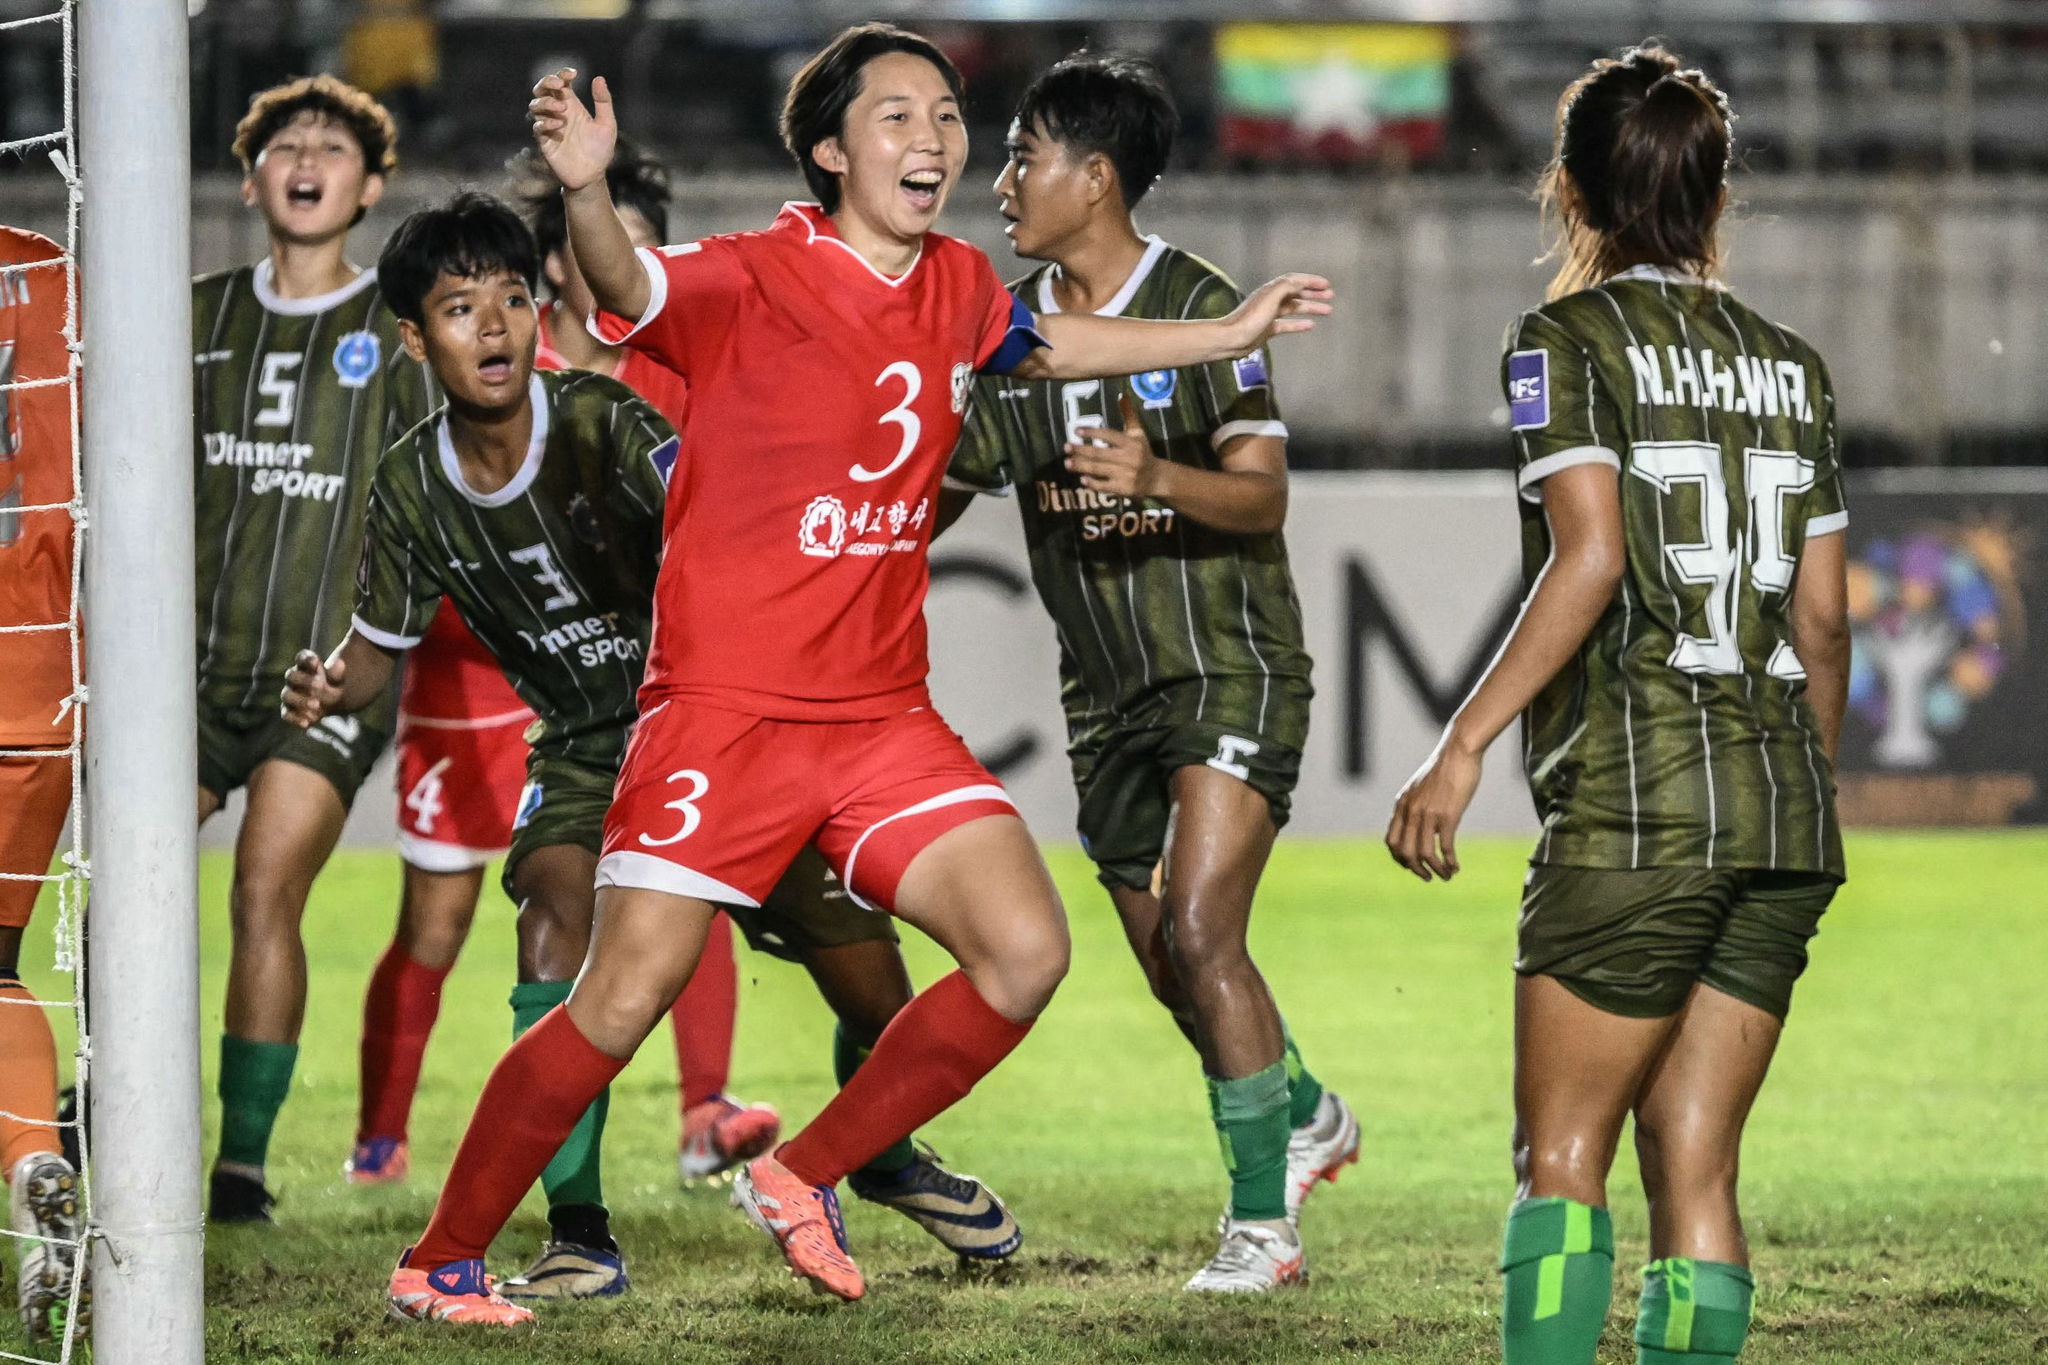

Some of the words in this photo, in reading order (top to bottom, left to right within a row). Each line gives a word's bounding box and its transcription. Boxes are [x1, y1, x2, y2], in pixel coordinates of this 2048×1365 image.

[254, 351, 303, 427] 5
[849, 360, 923, 483] 3
[203, 431, 314, 468] Dinner
[251, 468, 346, 501] SPORT
[1037, 480, 1132, 512] Dinne
[1083, 508, 1175, 540] SPORT
[508, 542, 579, 612] 3
[405, 757, 453, 835] 4
[638, 769, 709, 846] 3
